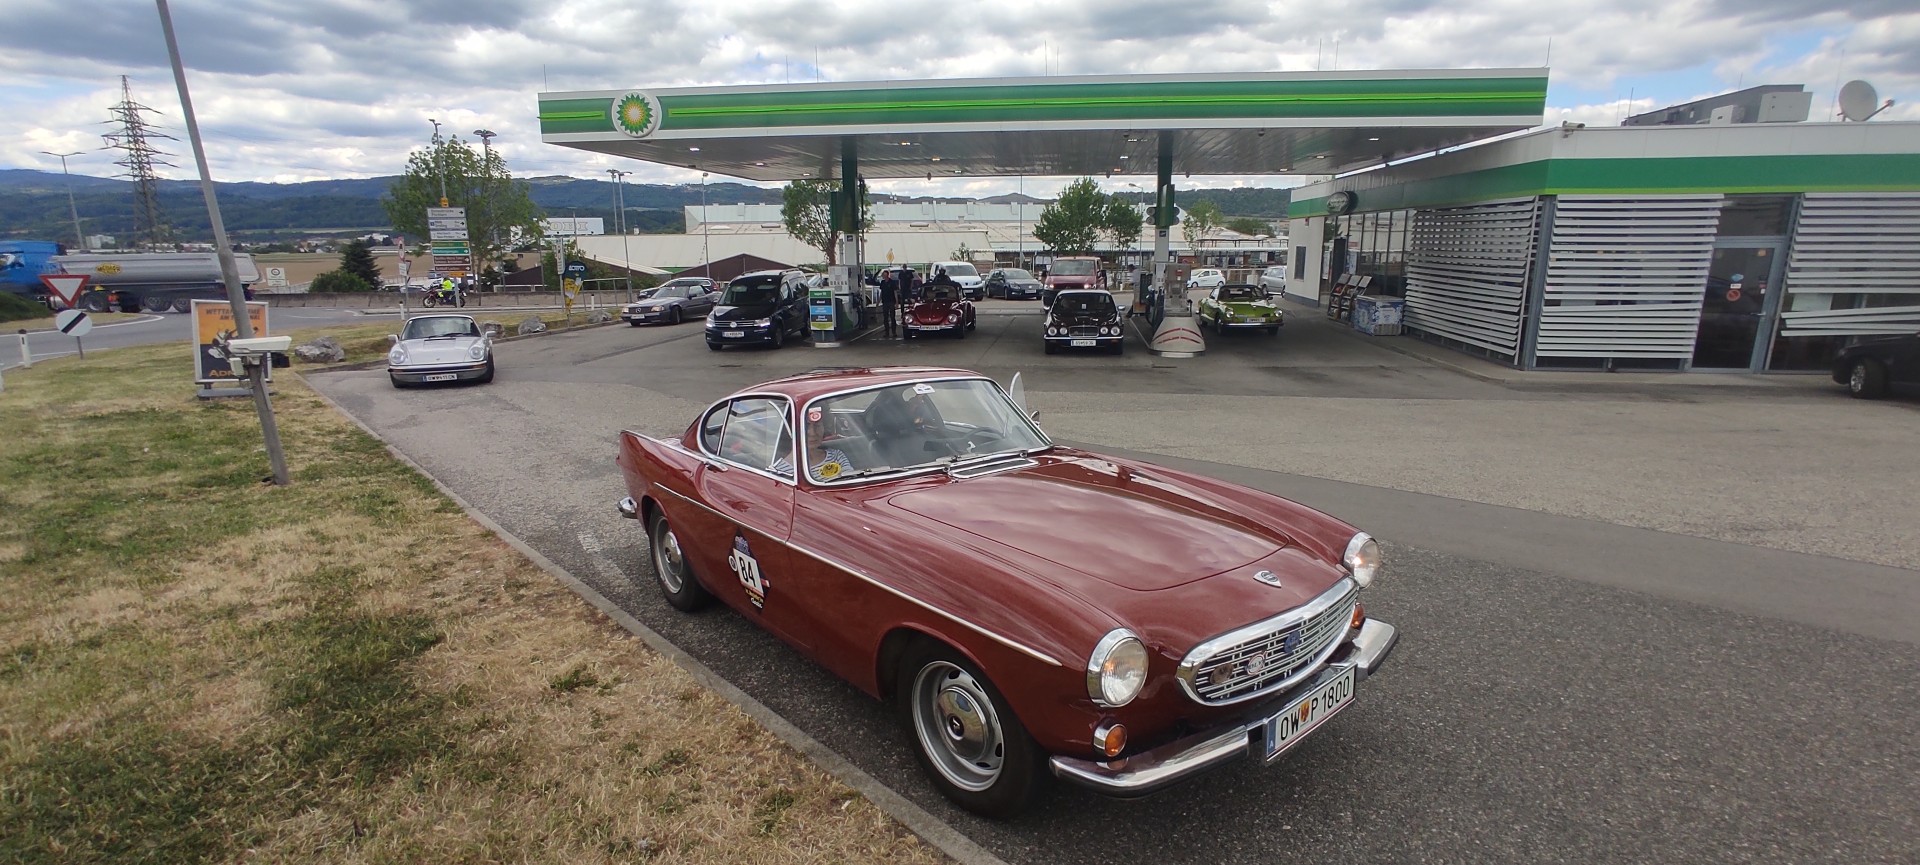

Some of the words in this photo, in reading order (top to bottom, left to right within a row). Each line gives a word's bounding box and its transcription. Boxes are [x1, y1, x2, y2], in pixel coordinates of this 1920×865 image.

[739, 556, 756, 587] 84
[1280, 708, 1300, 741] OW
[1311, 697, 1318, 722] P
[1321, 675, 1350, 713] 1800
